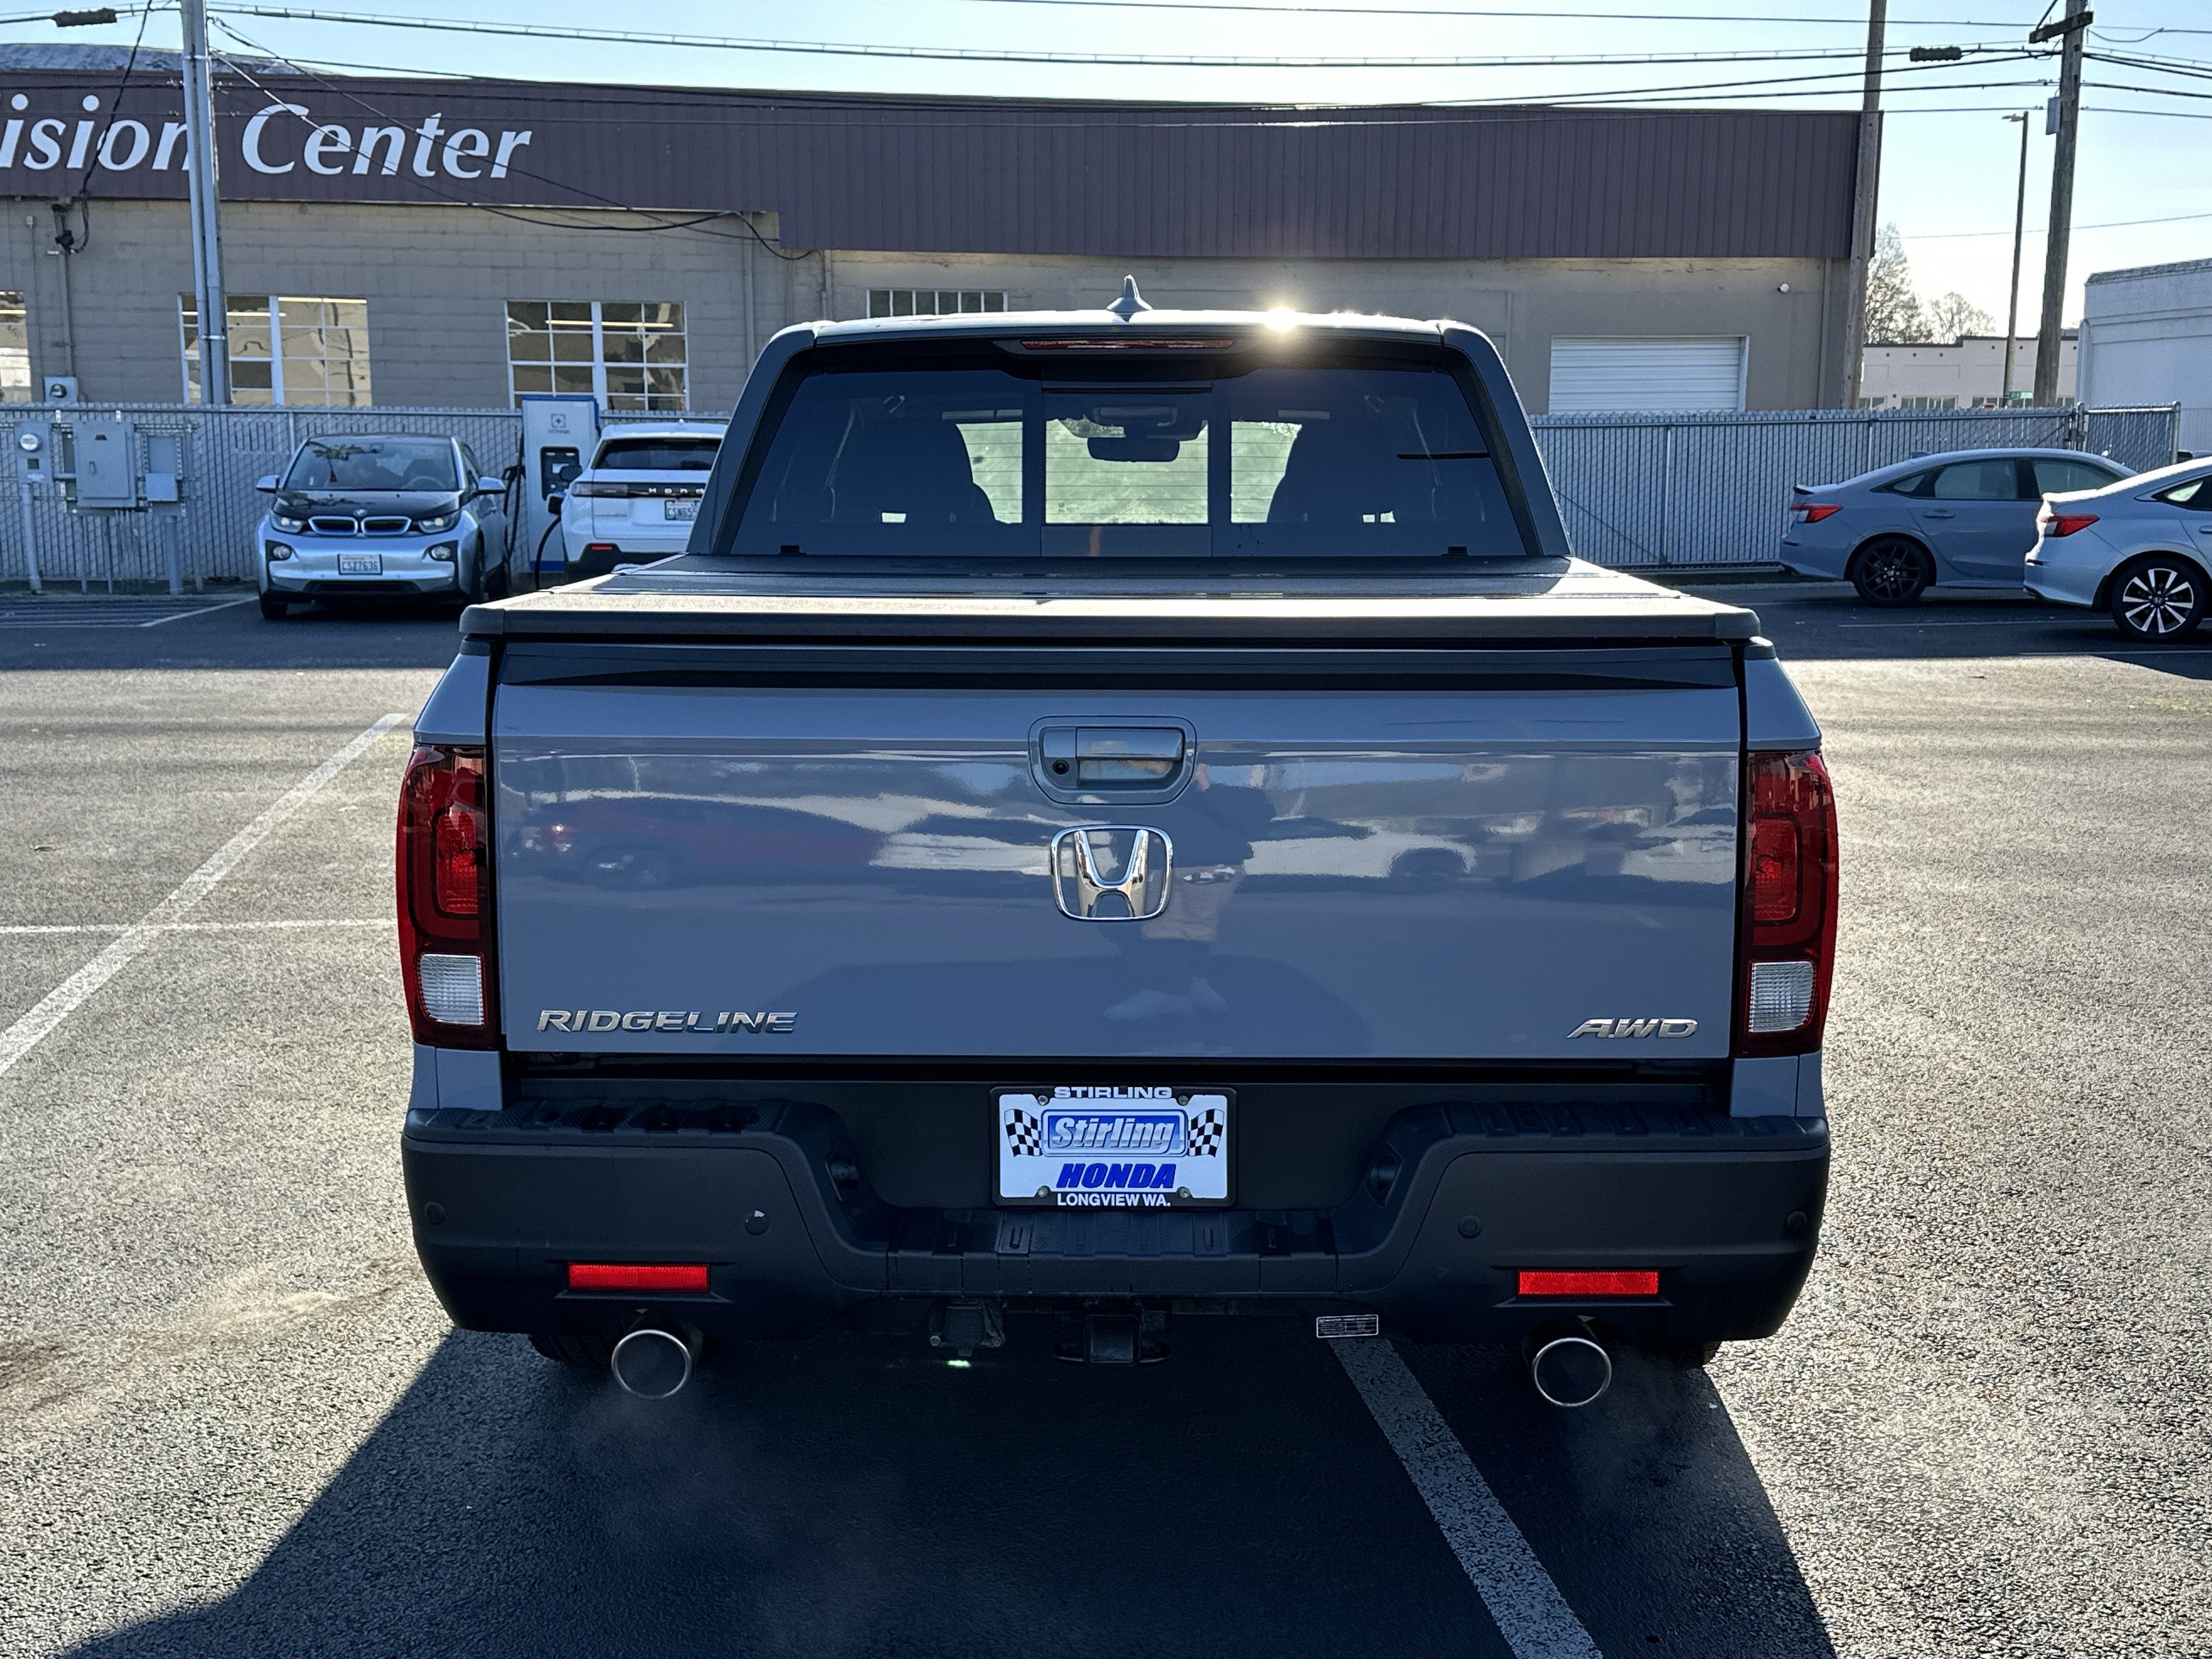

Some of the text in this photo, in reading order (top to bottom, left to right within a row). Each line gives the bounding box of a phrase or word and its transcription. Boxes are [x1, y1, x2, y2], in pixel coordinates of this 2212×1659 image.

[242, 103, 532, 179] Center
[537, 1010, 797, 1032] RIDGELINE
[1566, 1018, 1698, 1038] AWD
[1054, 1087, 1172, 1098] STIRLING
[1052, 1118, 1175, 1153] Stirling
[1056, 1163, 1176, 1188] HONDA
[1057, 1193, 1171, 1206] LONGVIEW WA.
